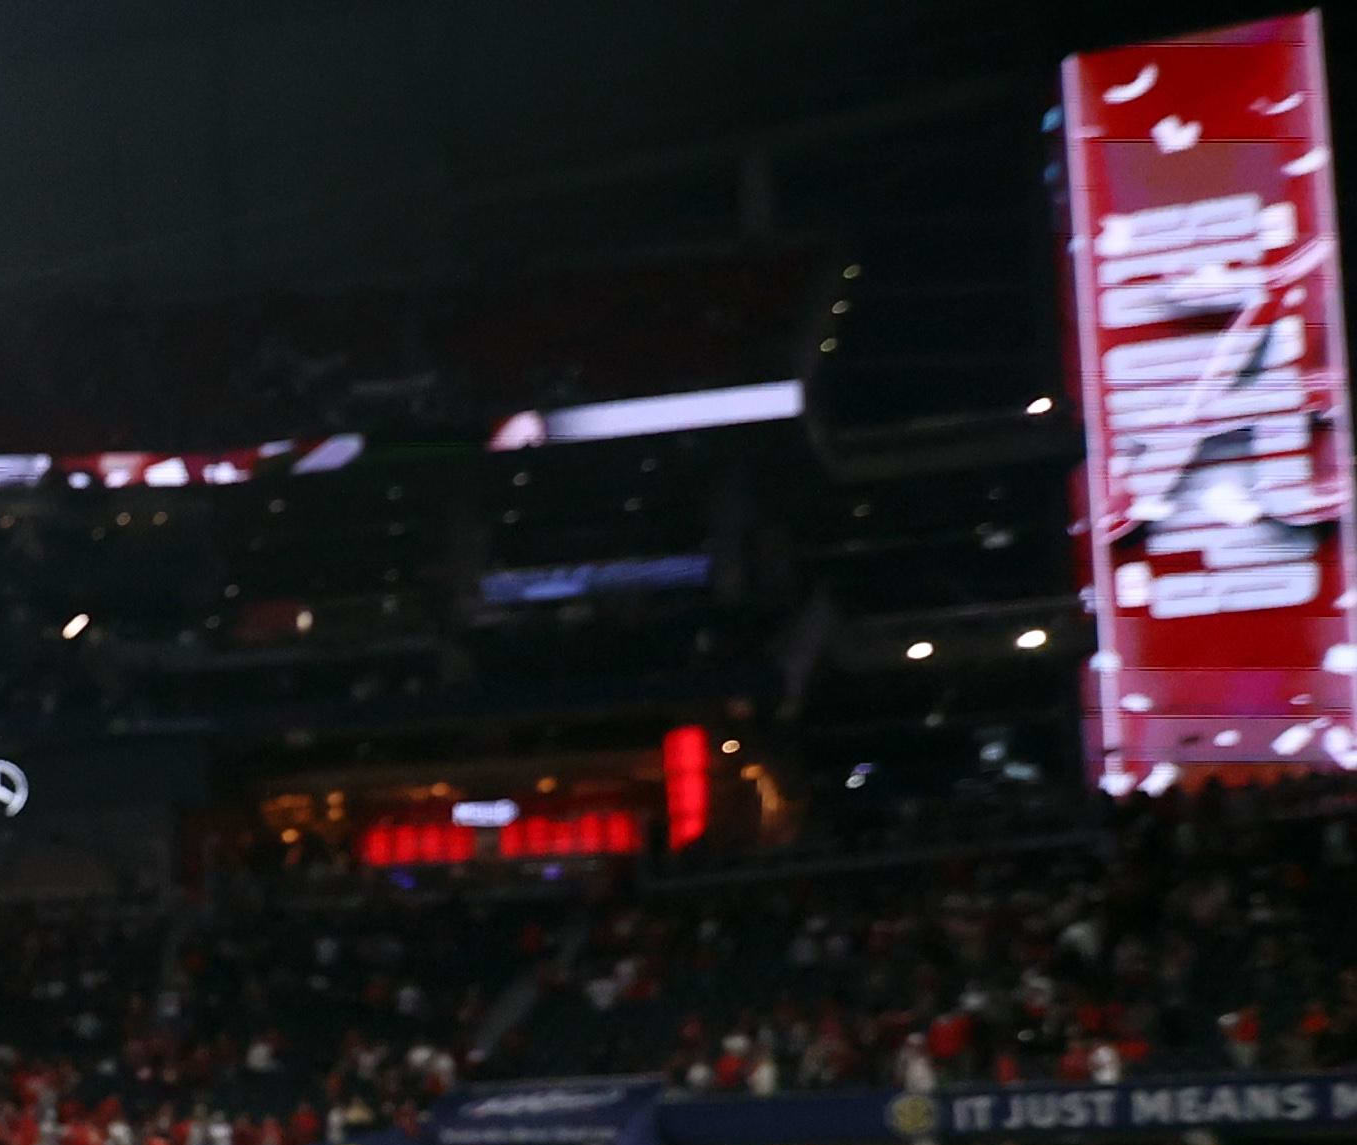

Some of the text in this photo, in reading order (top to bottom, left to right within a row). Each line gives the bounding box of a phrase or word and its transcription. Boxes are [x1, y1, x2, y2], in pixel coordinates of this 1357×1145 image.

[952, 1094, 991, 1131] IT
[1002, 1090, 1115, 1130] JUST
[1130, 1083, 1316, 1124] MEANS
